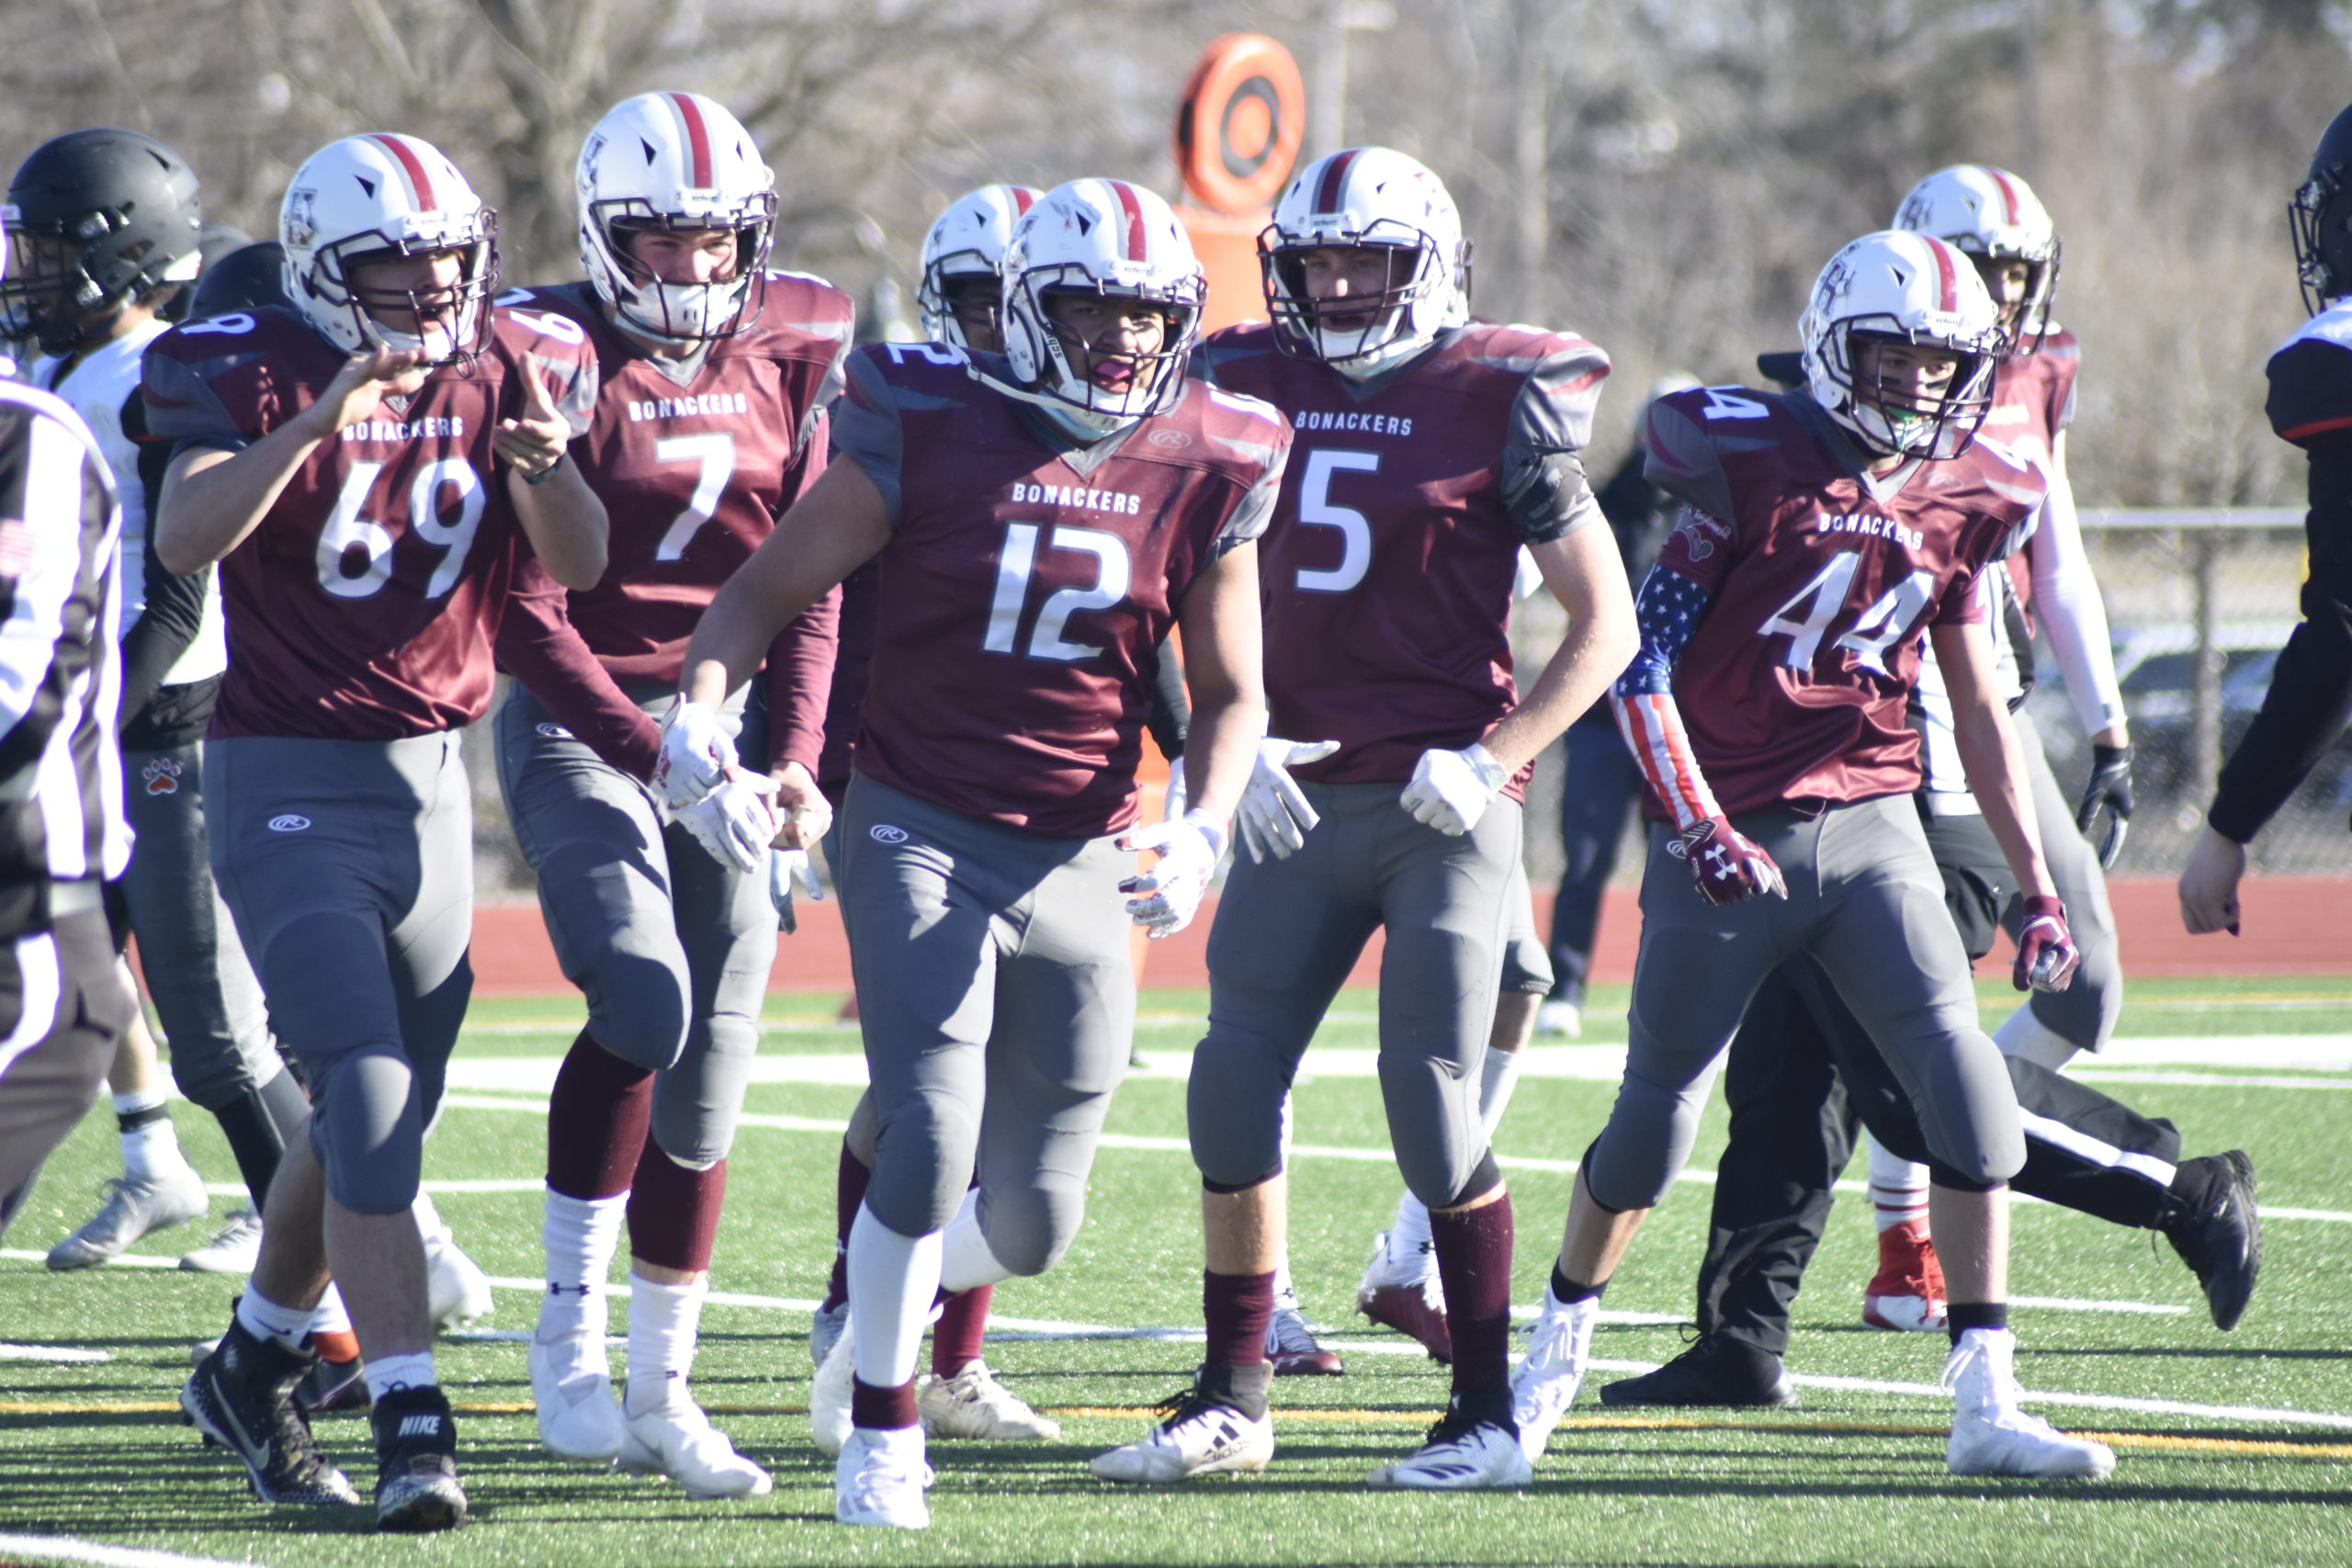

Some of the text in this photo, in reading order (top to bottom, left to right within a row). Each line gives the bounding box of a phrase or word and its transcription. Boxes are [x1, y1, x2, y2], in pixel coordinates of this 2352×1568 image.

[628, 393, 748, 422] BONACKERS
[1295, 410, 1413, 436] BONACKERS
[342, 416, 464, 442] BONACKERS
[655, 432, 737, 561] 7
[1012, 481, 1141, 515] BONACKERS
[316, 457, 487, 600] 69
[1295, 448, 1383, 592] 5
[1818, 512, 1924, 552] BONACKERS
[983, 522, 1131, 661] 12
[1758, 551, 1936, 676] 44
[397, 1416, 441, 1438] NIKE
